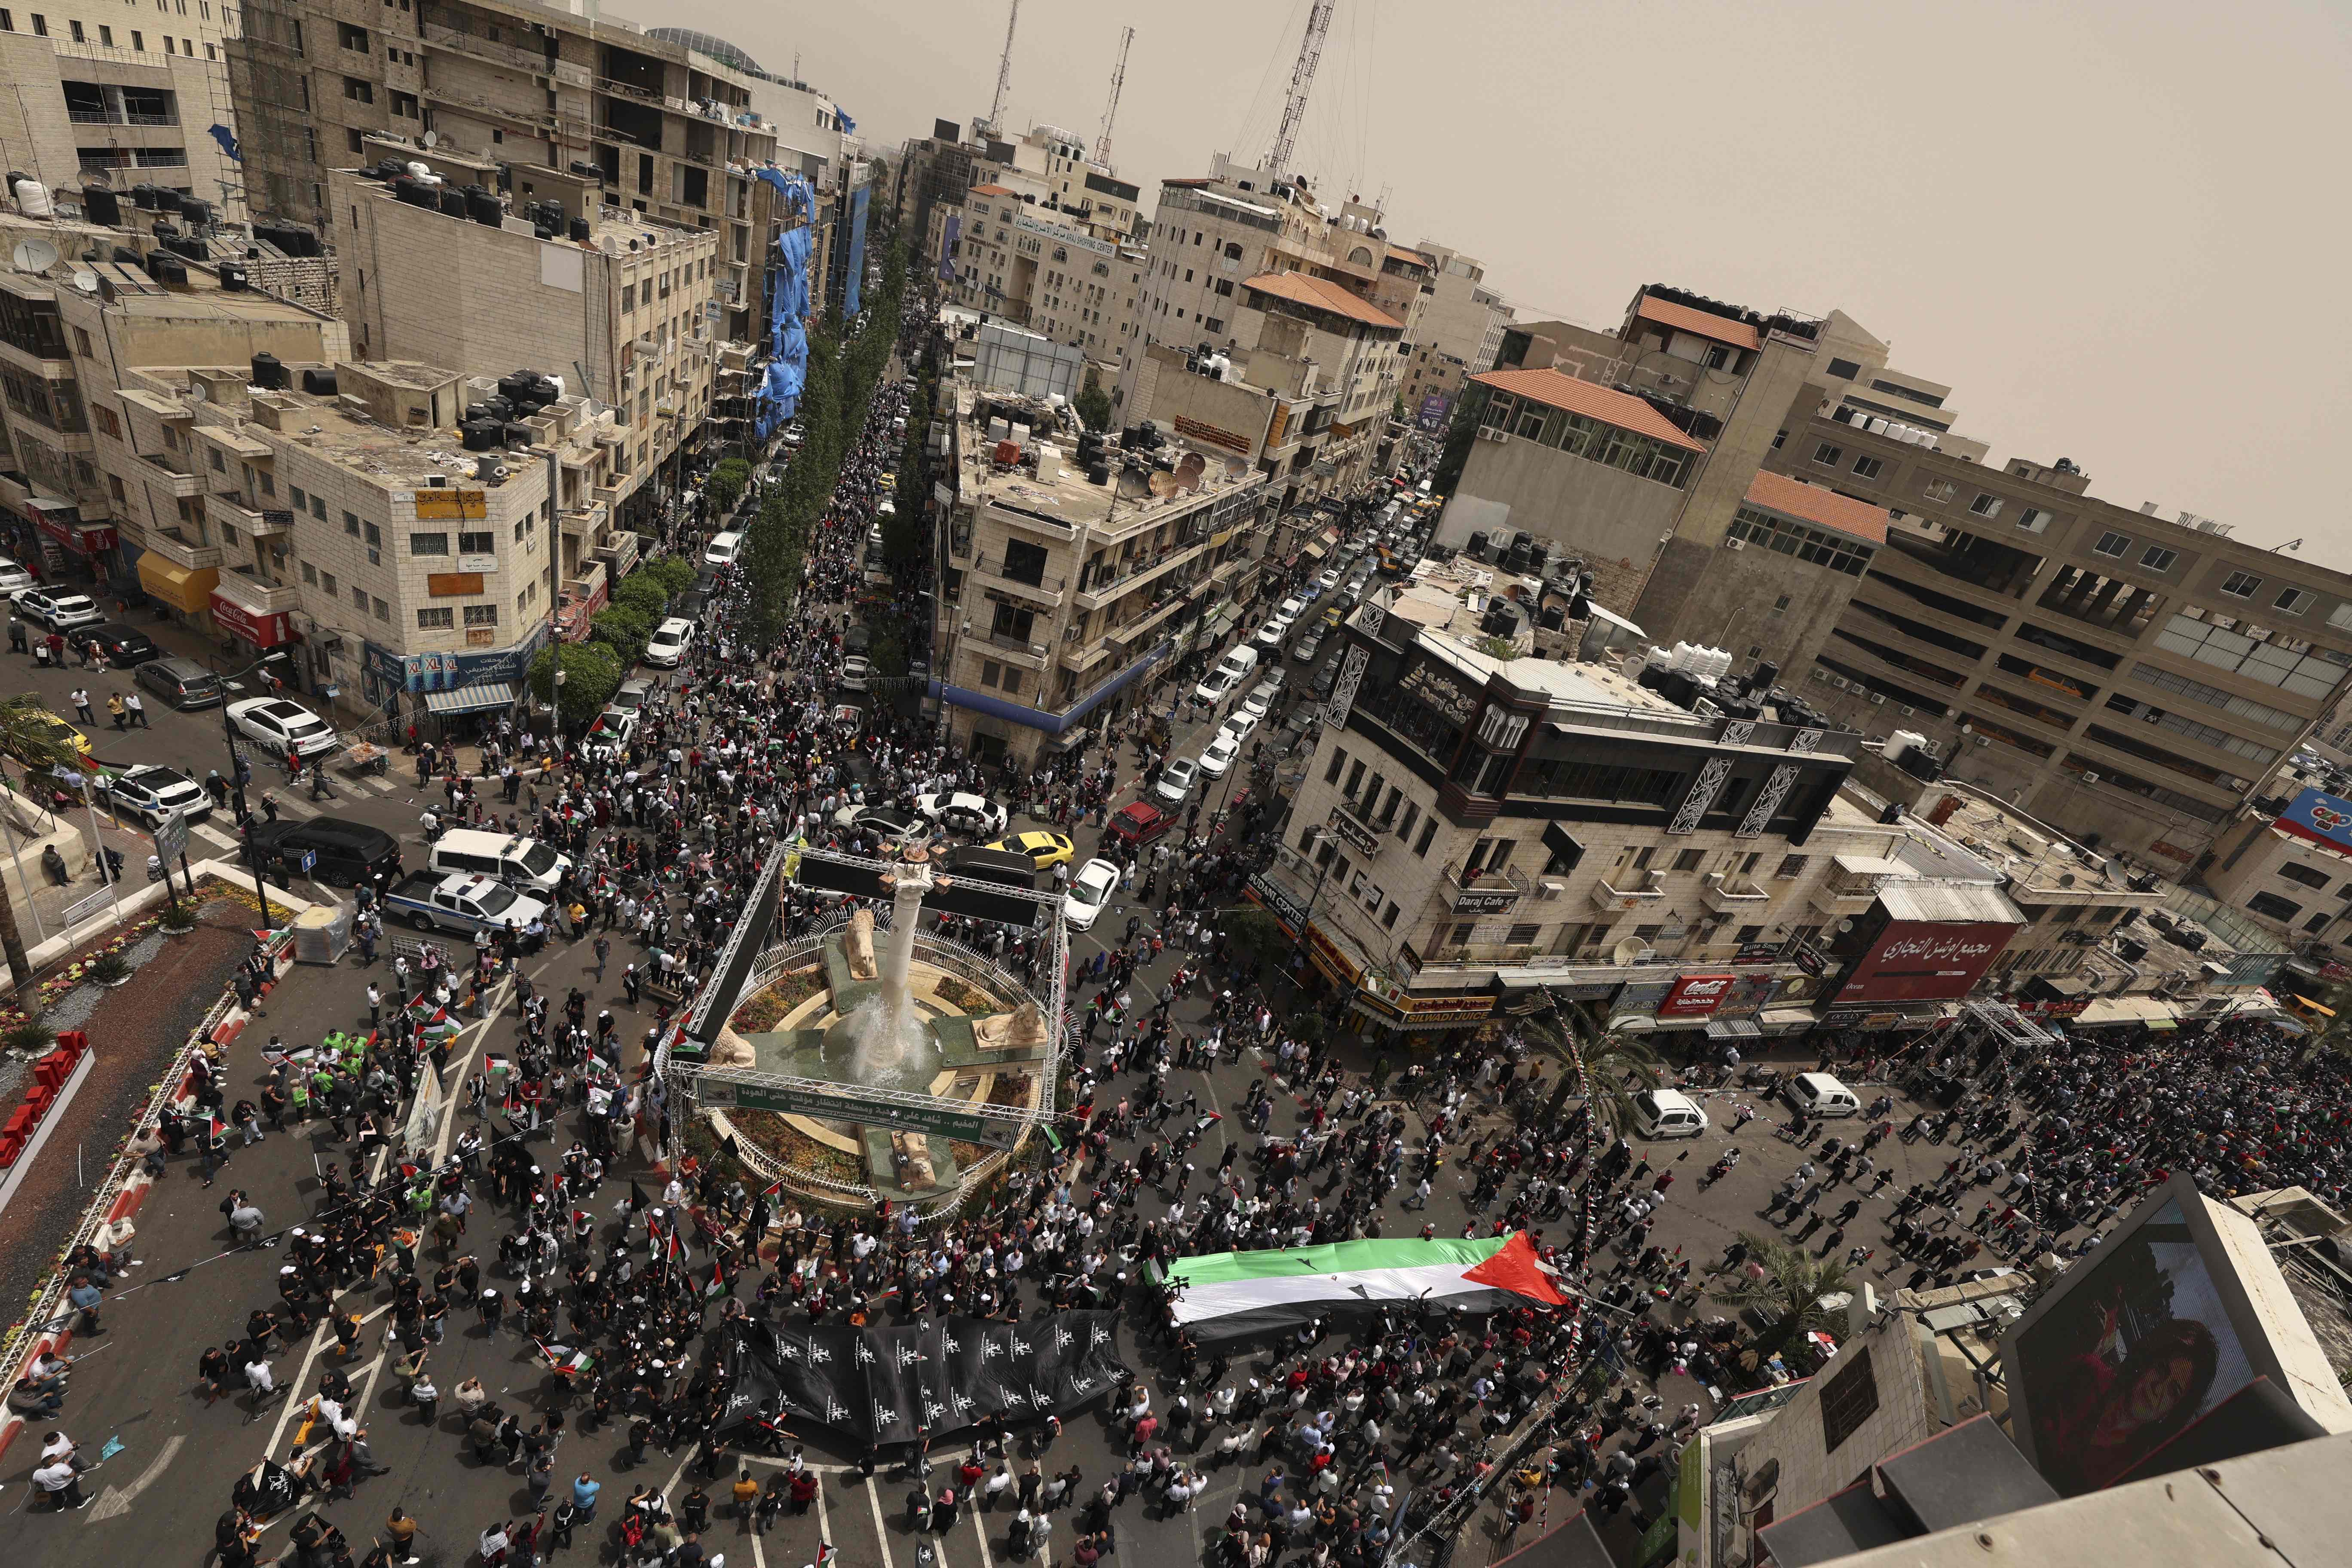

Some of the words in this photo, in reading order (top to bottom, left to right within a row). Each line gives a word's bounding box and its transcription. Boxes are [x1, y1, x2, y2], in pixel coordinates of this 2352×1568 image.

[1066, 233, 1076, 244] ARAJ
[1077, 236, 1096, 248] SHOPPING
[1097, 242, 1112, 254] CENTER
[220, 601, 248, 625] Coca-Cola
[408, 662, 422, 674] XL
[425, 657, 441, 671] XL
[444, 659, 458, 671] XL
[1420, 686, 1446, 712] Daraj
[1248, 873, 1275, 900] SUDANI
[1458, 897, 1482, 907] Daraj
[1483, 898, 1504, 906] Cafe
[1743, 943, 1761, 952] Elite
[1762, 943, 1779, 952] Smile
[1881, 937, 1932, 963] التجاري
[1954, 943, 1991, 962] مجمع
[1309, 943, 1327, 965] SILWADI
[1326, 961, 1340, 979] JUICE
[1683, 980, 1727, 995] Coca-Cola
[1409, 1013, 1458, 1022] SILWADI
[1460, 1011, 1488, 1020] JUICE
[741, 1088, 766, 1098] العودة
[789, 1094, 813, 1104] مؤقتة
[844, 1102, 873, 1115] ومحطة
[903, 1111, 919, 1121] على
[922, 1114, 942, 1124] شاهد
[952, 1119, 979, 1129] المخيم
